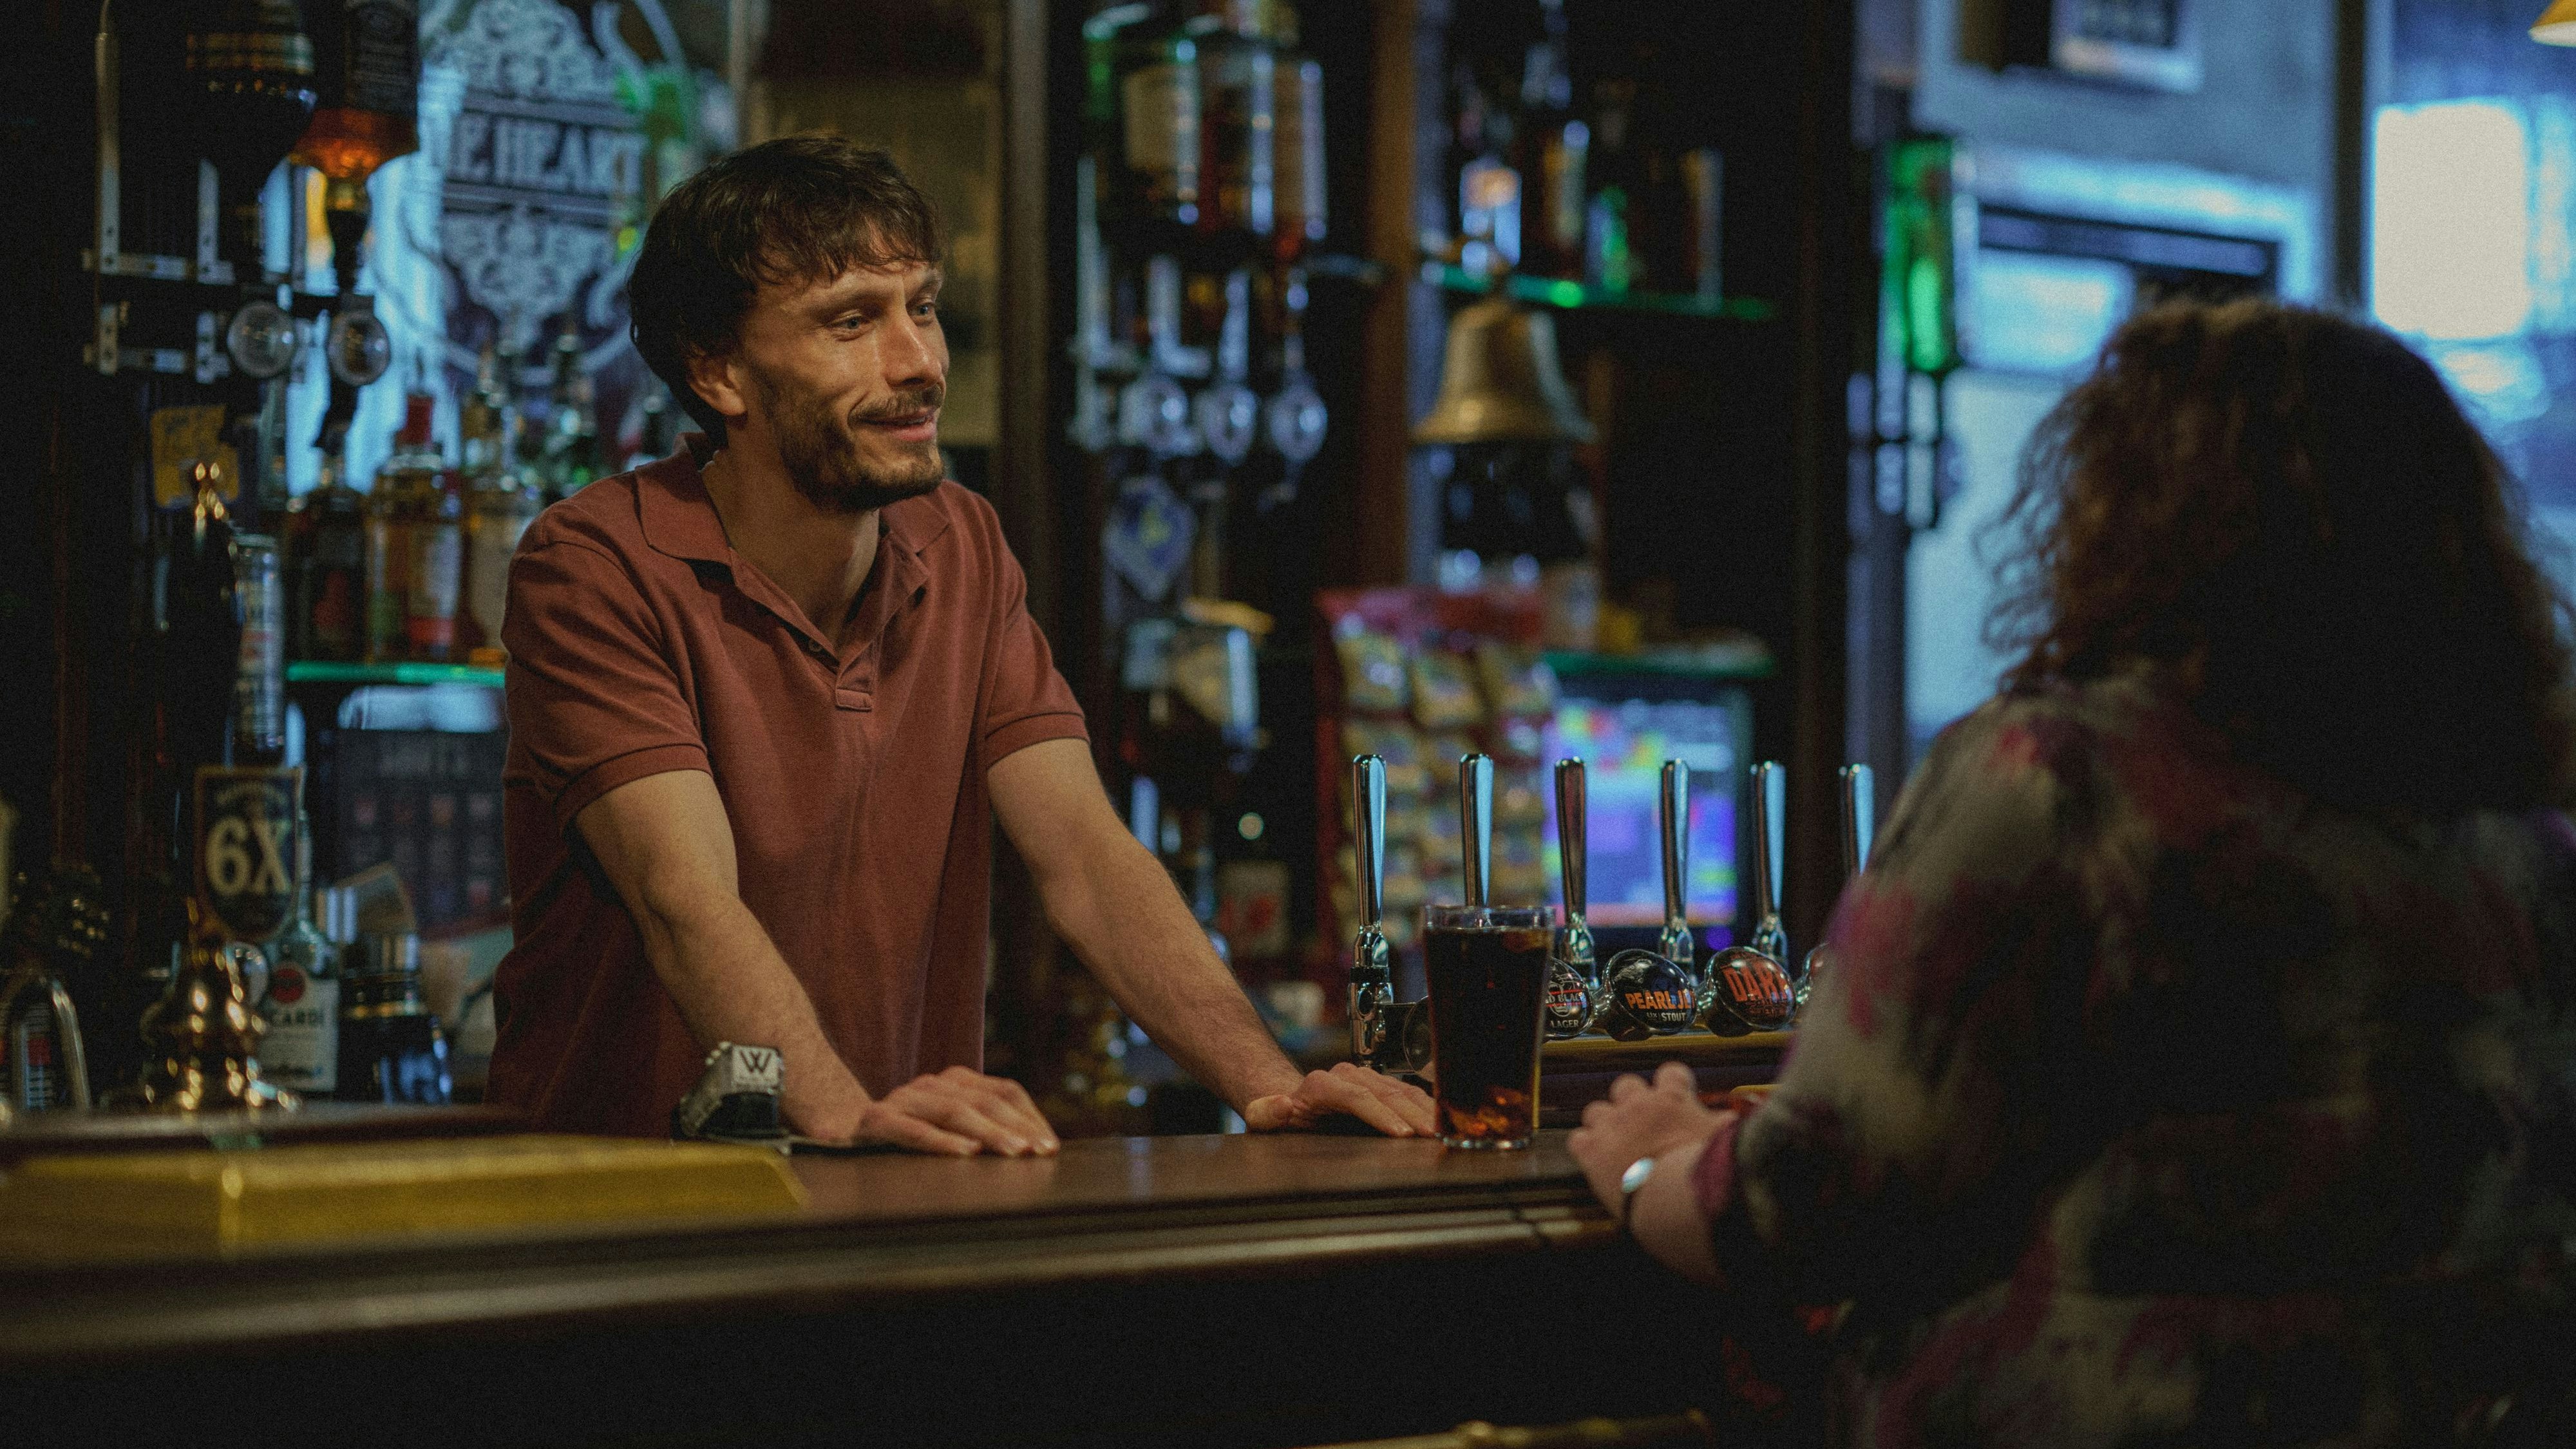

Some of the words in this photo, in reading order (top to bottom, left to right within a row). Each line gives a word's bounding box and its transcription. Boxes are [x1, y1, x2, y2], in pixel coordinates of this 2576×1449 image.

[205, 816, 292, 896] 6X
[1558, 992, 1581, 1003] BLAC
[1625, 990, 1676, 1010] PEARL
[1662, 1012, 1686, 1021] STOUT
[1551, 1019, 1579, 1028] LAGER
